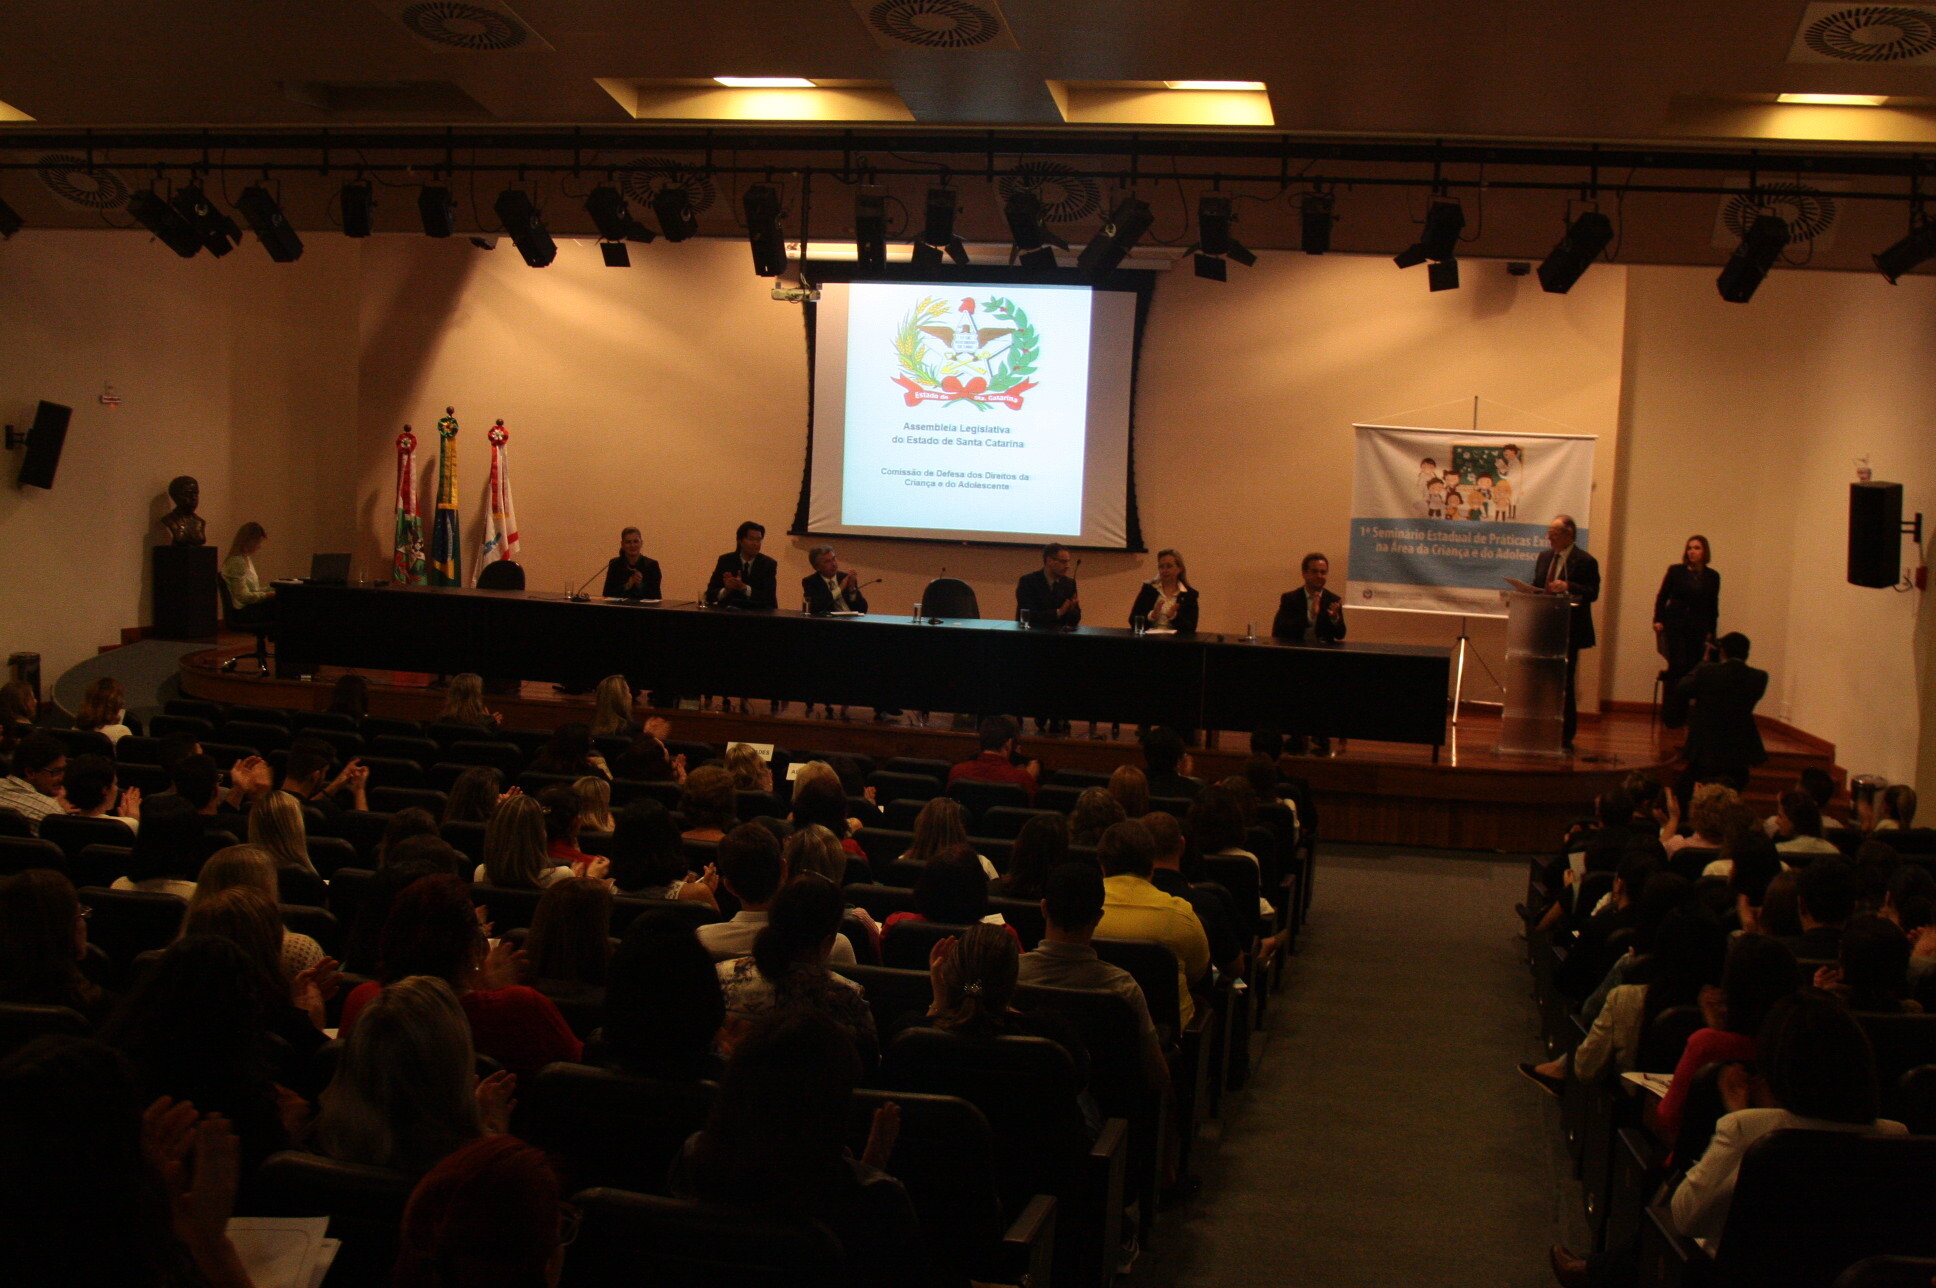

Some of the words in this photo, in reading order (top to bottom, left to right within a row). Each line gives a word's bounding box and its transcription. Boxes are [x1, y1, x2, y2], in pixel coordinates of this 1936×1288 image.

[903, 422, 957, 432] Assembleia
[960, 424, 1011, 435] Legislativa
[892, 435, 904, 444] do
[906, 435, 939, 445] Estado
[941, 437, 954, 446] de
[956, 438, 983, 447] Santa
[985, 439, 1024, 448] Catarina
[881, 467, 922, 477] Comissão
[923, 469, 934, 477] de
[936, 469, 965, 478] Defesa
[967, 470, 983, 479] dos
[985, 471, 1017, 481] Direitos
[1018, 473, 1030, 481] da
[904, 479, 936, 488] Criança
[945, 480, 956, 488] do
[958, 481, 1010, 491] Adolescente
[1372, 526, 1425, 541] Seminário
[1427, 529, 1472, 543] Estadual
[1473, 532, 1487, 544] de
[1489, 532, 1532, 546] Práticas
[1376, 543, 1390, 552] na
[1391, 540, 1415, 554] Área
[1416, 543, 1430, 555] da
[1432, 544, 1470, 559] Criança
[1471, 549, 1479, 558] e
[1480, 547, 1494, 559] do
